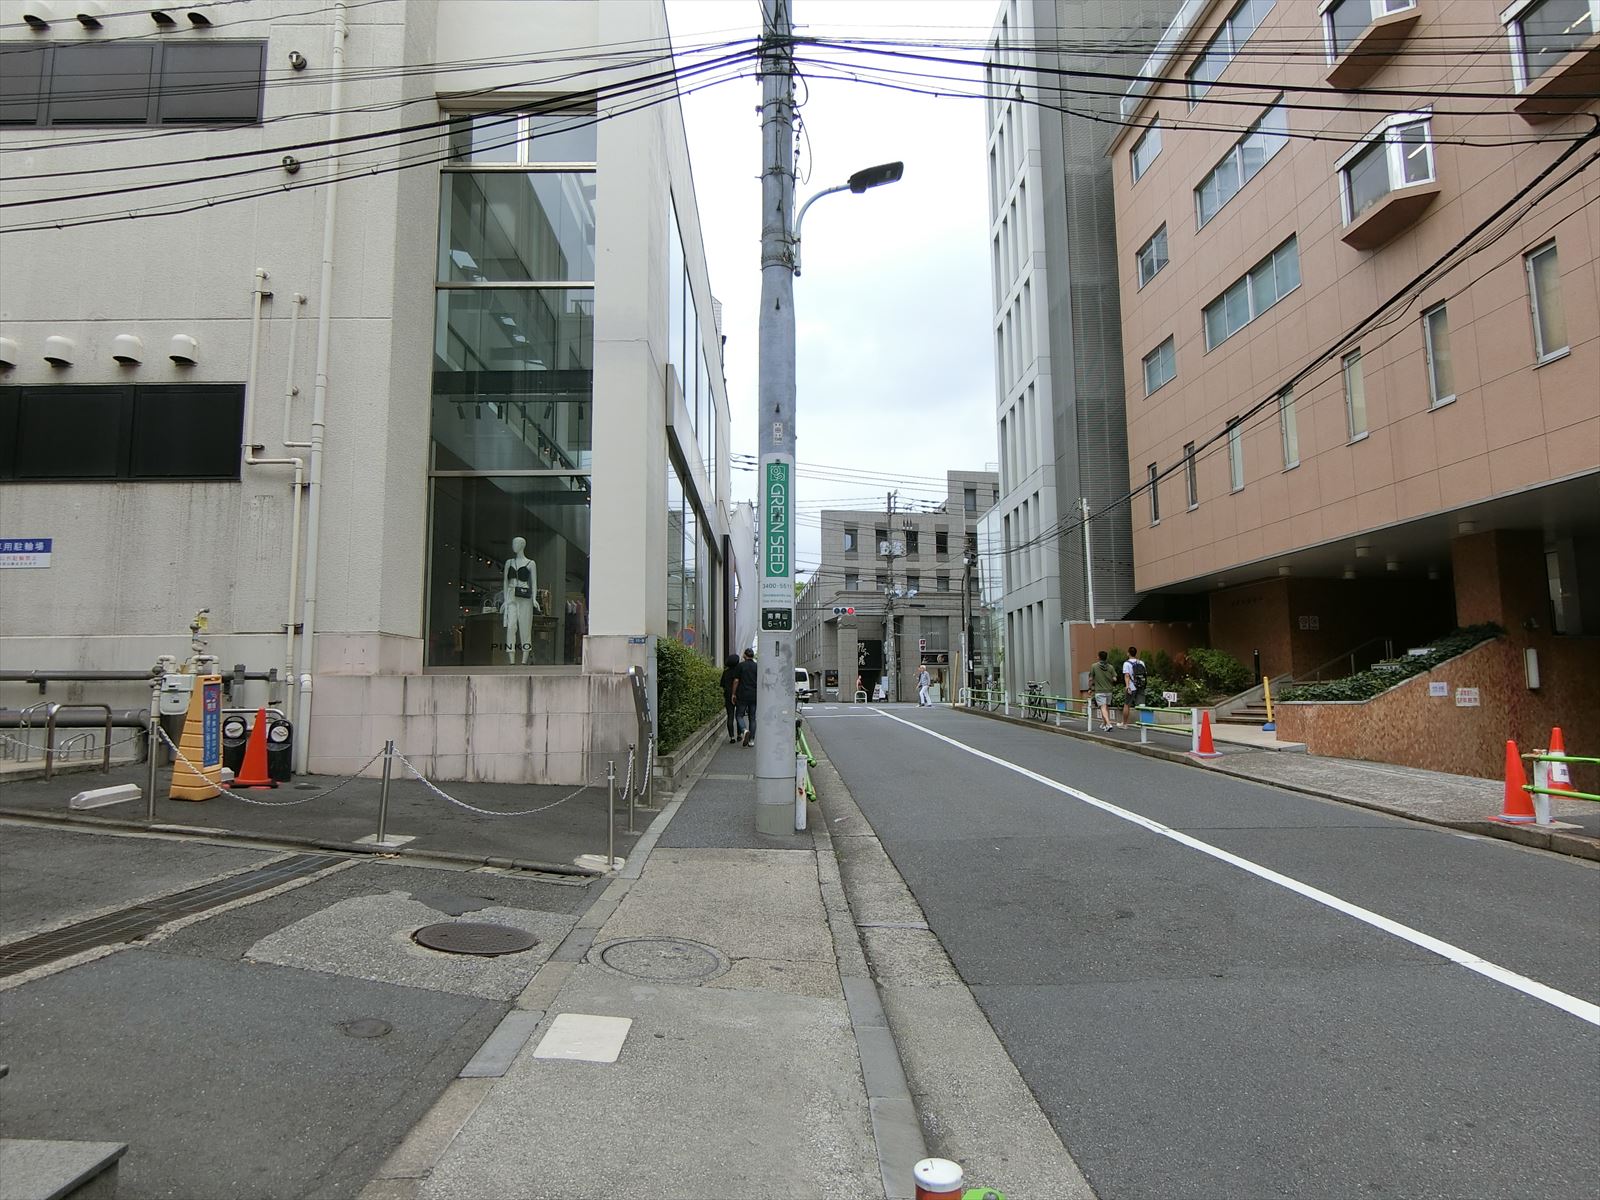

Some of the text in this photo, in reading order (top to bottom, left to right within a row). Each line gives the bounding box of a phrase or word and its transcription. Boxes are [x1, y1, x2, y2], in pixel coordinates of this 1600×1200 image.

[0, 542, 44, 551] 用駐輪場
[771, 483, 784, 574] GREEN SEED
